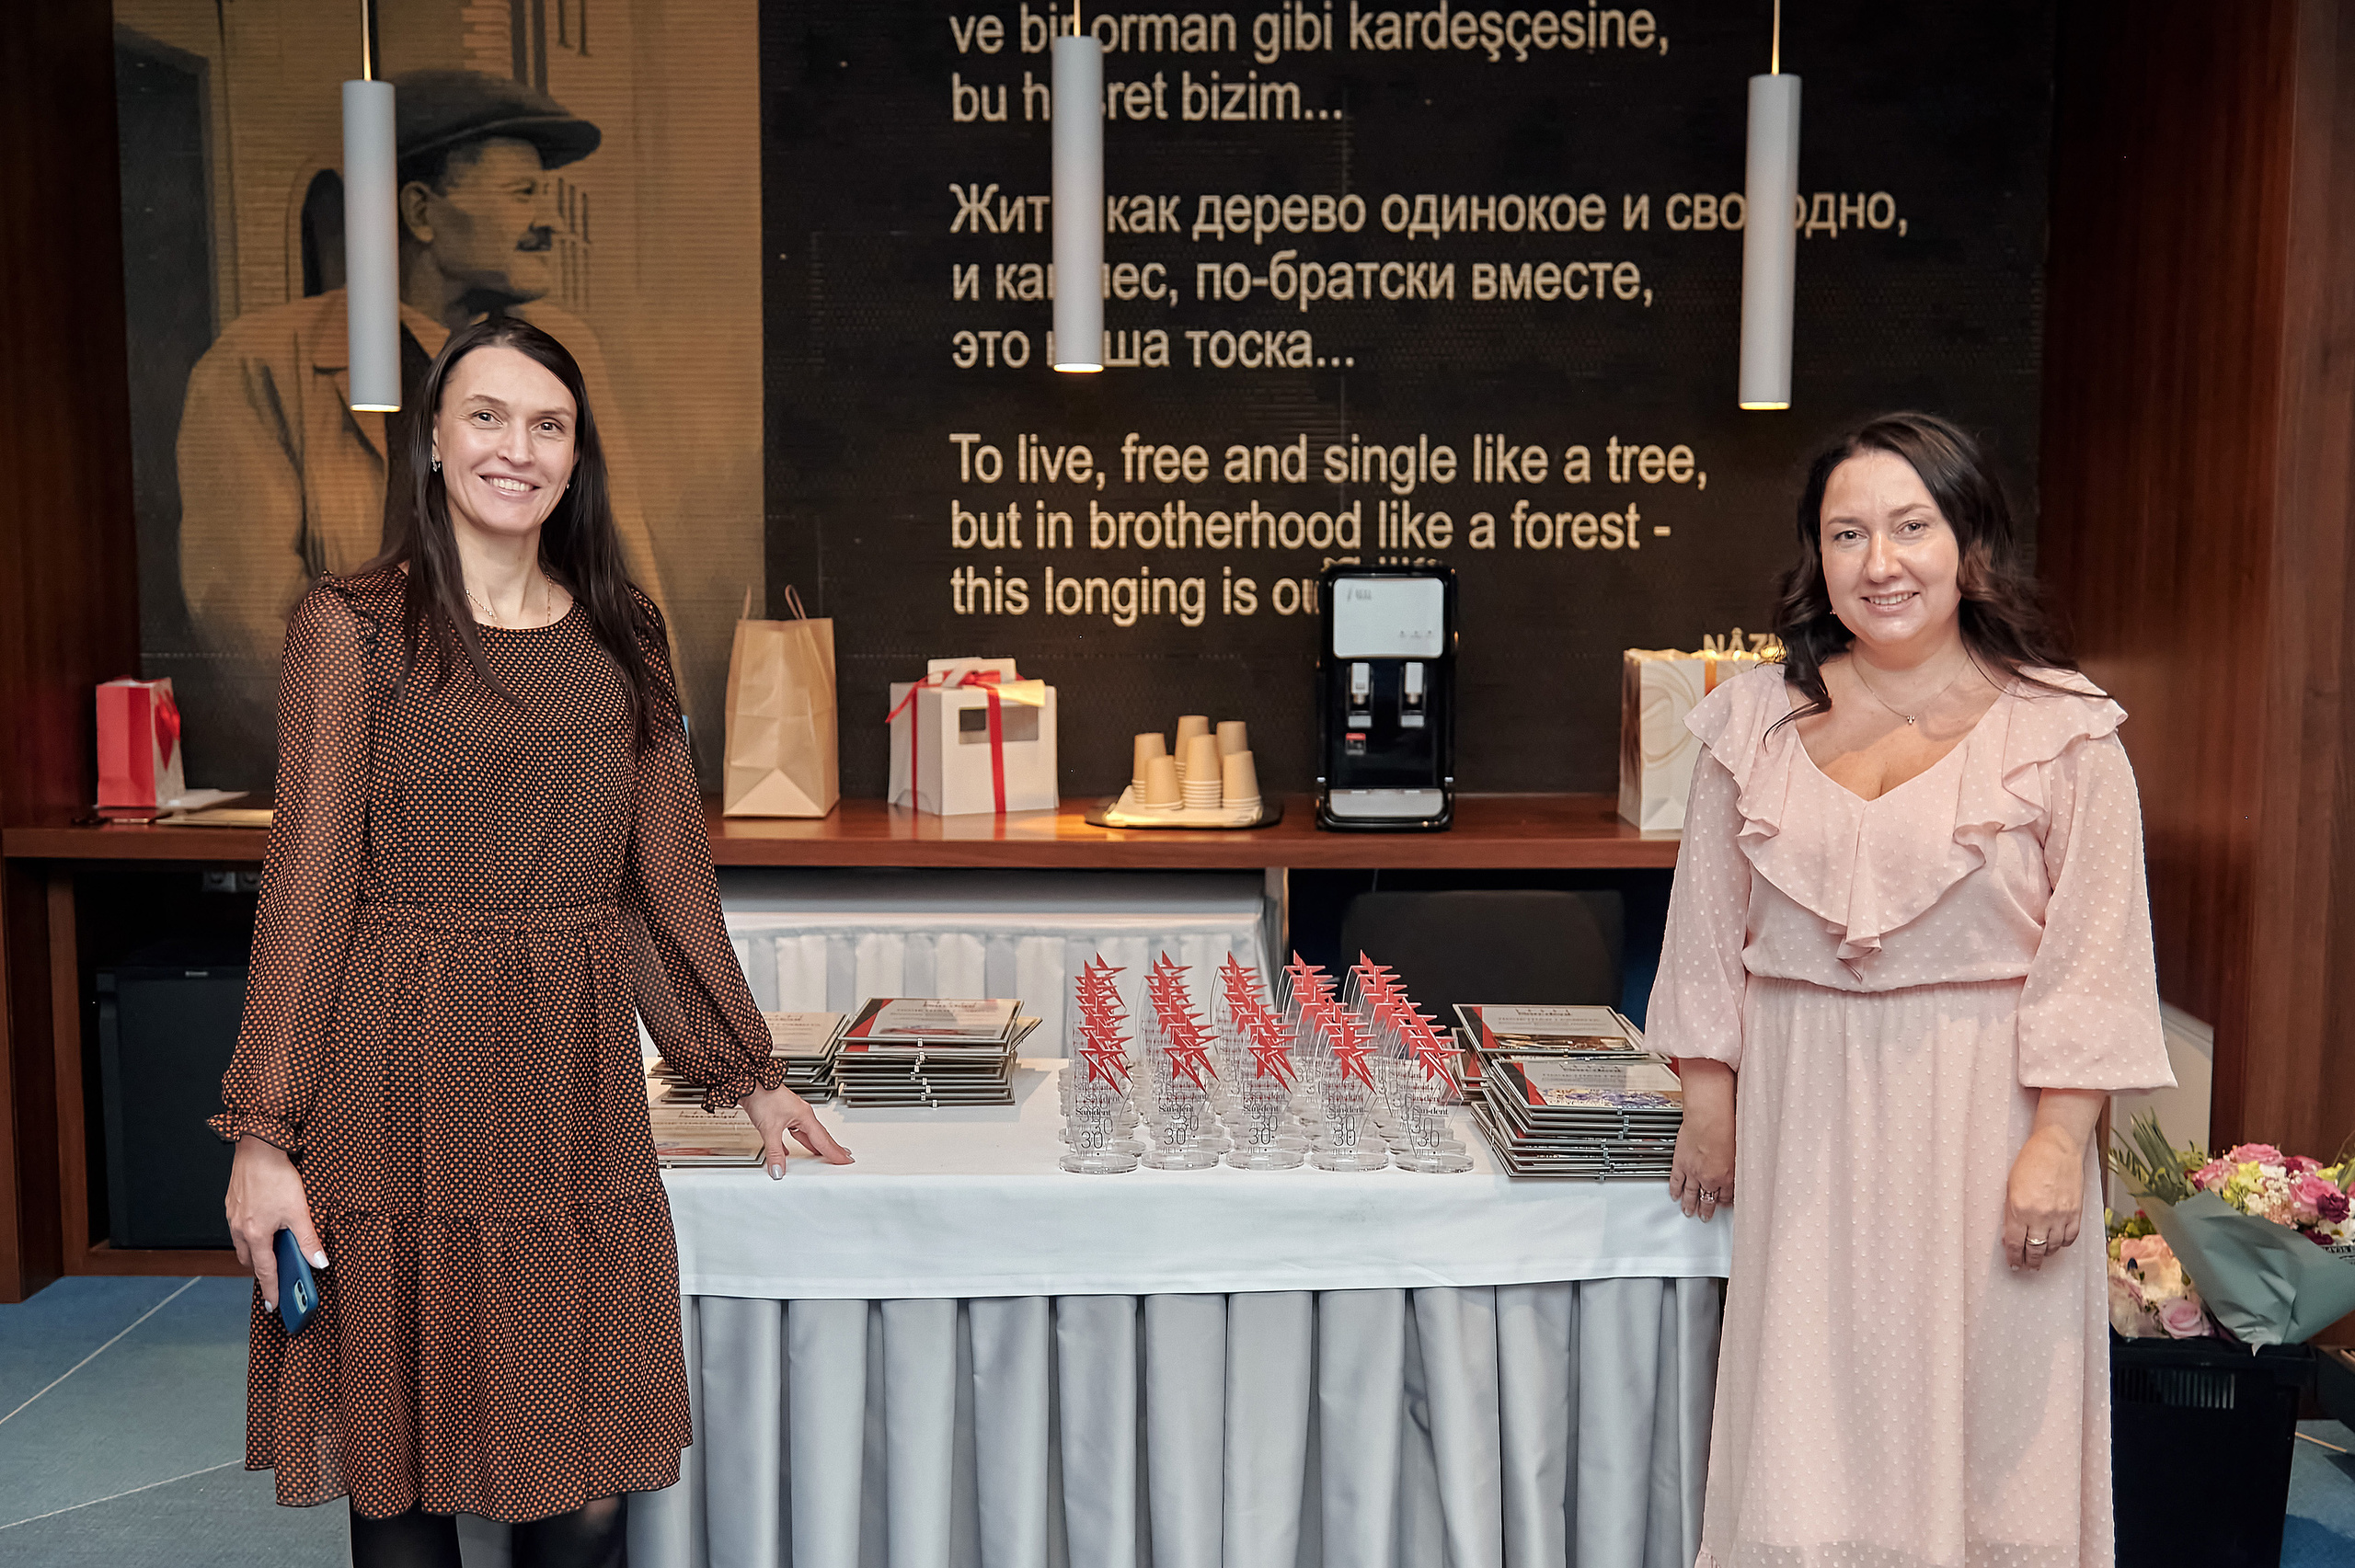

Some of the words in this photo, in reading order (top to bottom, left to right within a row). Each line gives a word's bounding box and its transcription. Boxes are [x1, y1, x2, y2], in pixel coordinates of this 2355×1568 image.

[949, 15, 1005, 53] ve
[1091, 13, 1236, 53] orman
[1253, 0, 1333, 63] gibi
[1350, 0, 1669, 62] kardeşçesine,
[952, 72, 1007, 121] bu
[1023, 70, 1168, 120] hret
[1182, 70, 1342, 120] bizim...
[949, 183, 1051, 234] Жит
[1108, 195, 1181, 233] как
[1192, 194, 1367, 244] дерево
[1381, 193, 1606, 240] одинокое
[1623, 194, 1649, 231] и
[1666, 191, 1907, 238] сводно,
[953, 263, 980, 301] и
[1196, 248, 1455, 313] по-братски
[1472, 261, 1653, 308] вместе,
[952, 330, 1030, 369] это
[1046, 329, 1170, 369] ша
[1185, 329, 1354, 369] тоска...
[948, 433, 1004, 484] To
[1017, 433, 1106, 491] live,
[1120, 432, 1210, 484] free
[1223, 433, 1307, 484] and
[1323, 433, 1457, 496] single
[1473, 433, 1549, 484] like
[1563, 445, 1591, 484] a
[1605, 435, 1707, 490] tree,
[951, 499, 1023, 550] but
[1036, 499, 1074, 550] in
[1089, 499, 1361, 550] brotherhood
[1378, 499, 1453, 549] like
[1468, 511, 1496, 549] a
[1511, 499, 1641, 550] forest
[949, 565, 1030, 615] this
[1045, 566, 1206, 627] longing
[1223, 566, 1258, 616] is
[1080, 1130, 1103, 1149] 30
[1163, 1127, 1186, 1145] 30
[1247, 1127, 1271, 1145] 30
[1333, 1129, 1356, 1147] 30
[1417, 1130, 1440, 1148] 30
